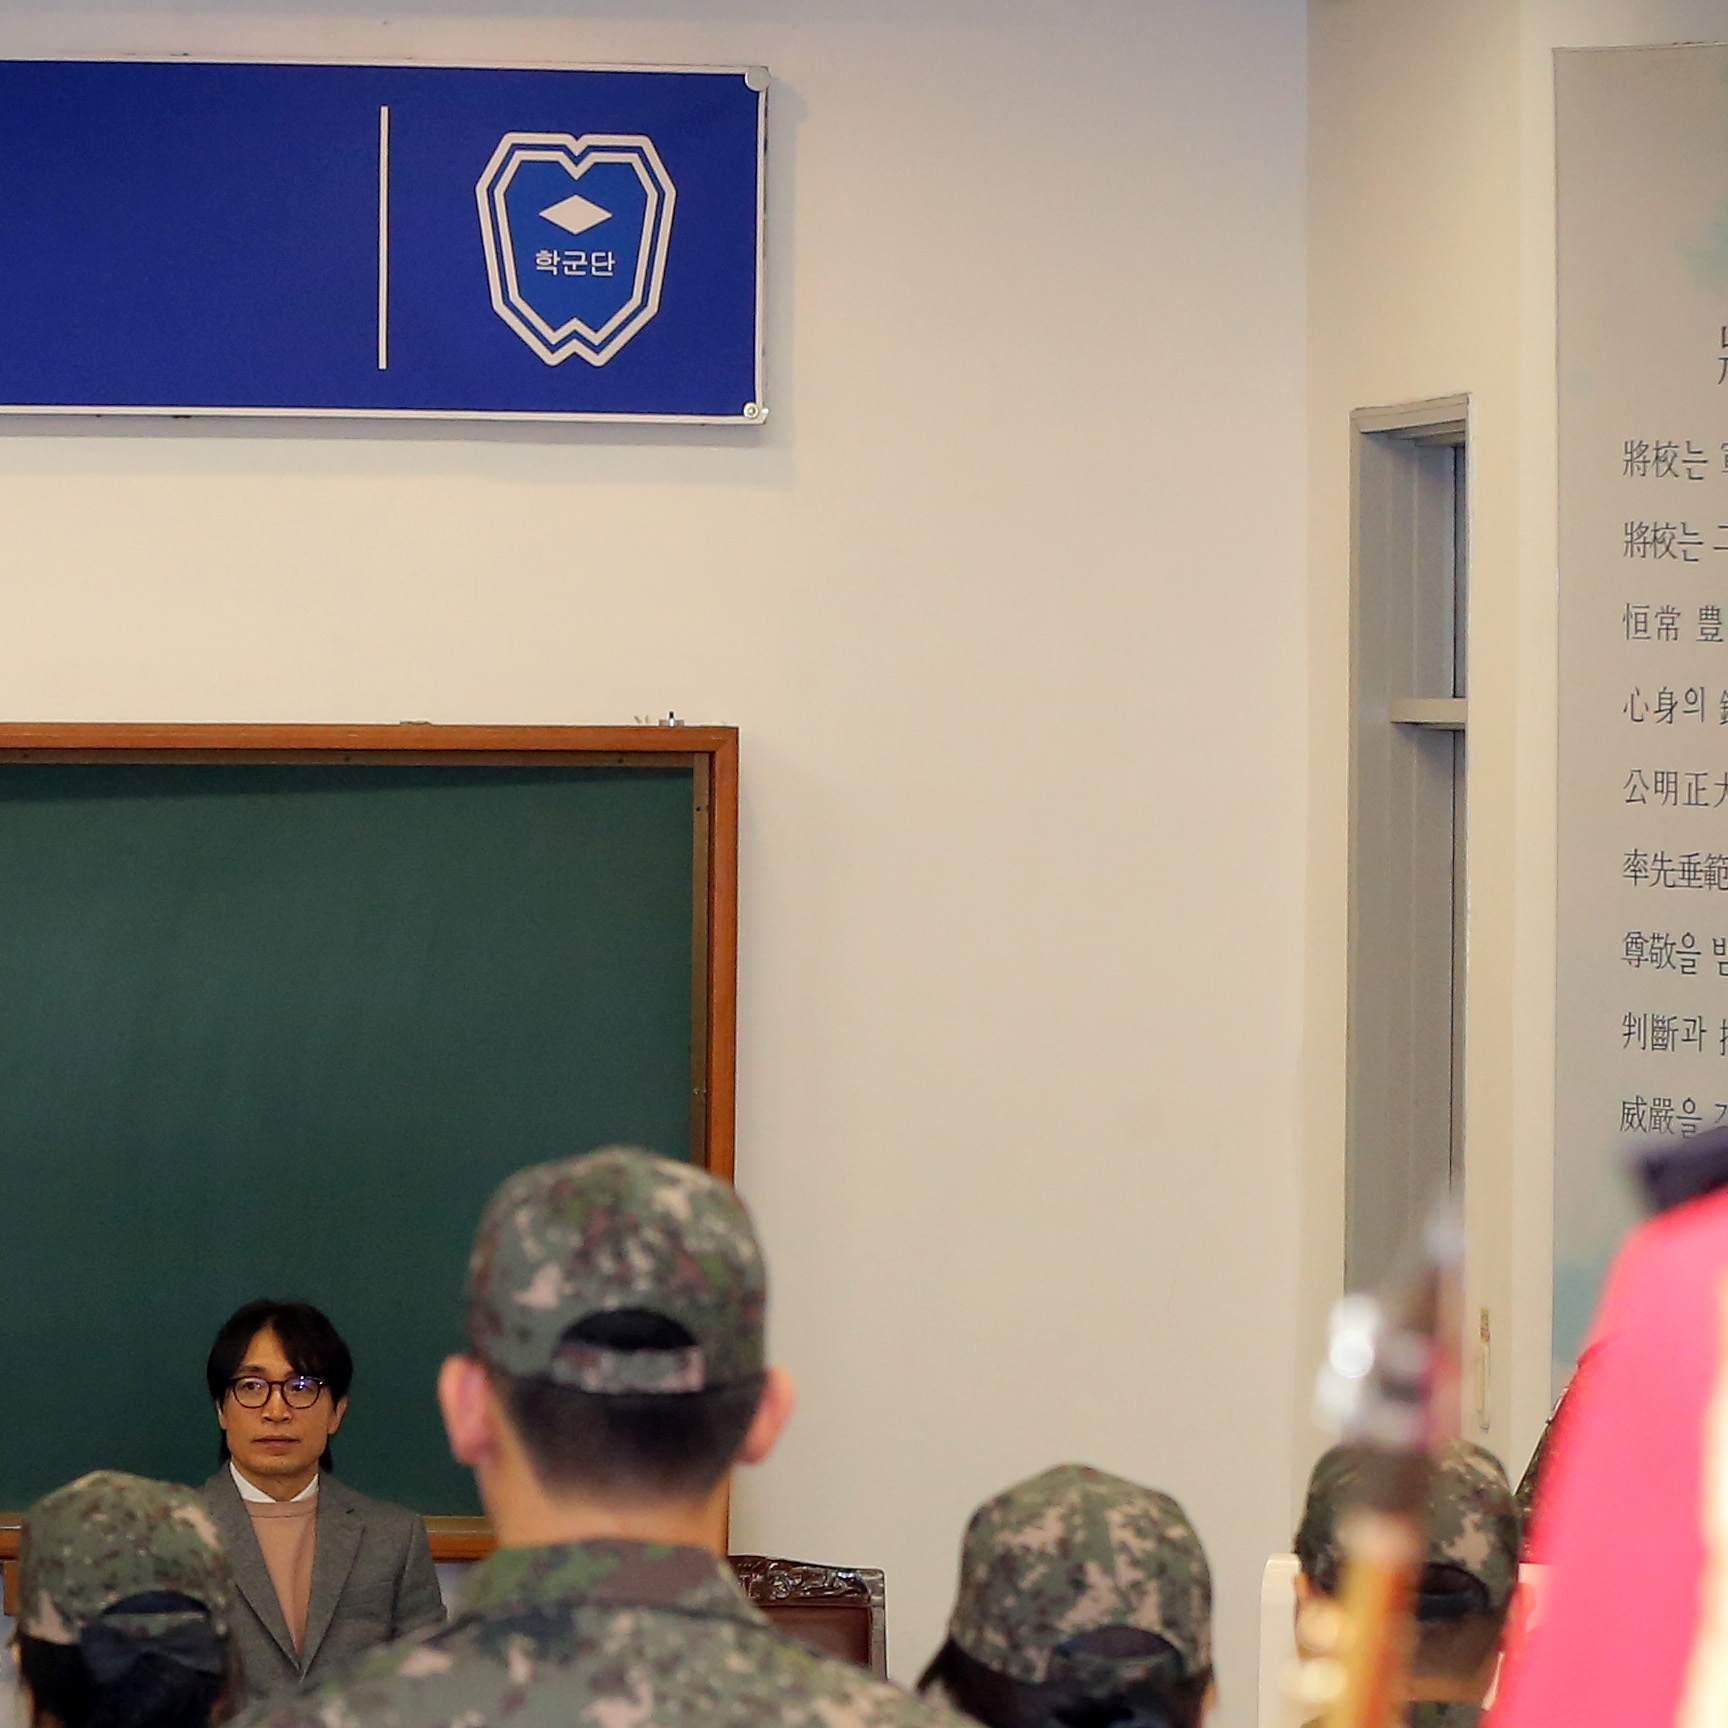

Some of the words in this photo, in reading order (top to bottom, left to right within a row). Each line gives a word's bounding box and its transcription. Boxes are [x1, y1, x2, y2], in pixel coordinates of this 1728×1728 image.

[534, 249, 616, 277] 학군단
[1623, 440, 1709, 481] 將校는
[1623, 521, 1704, 562] 將校는
[1623, 685, 1705, 725] 心身의
[1621, 931, 1702, 975] 尊敬을
